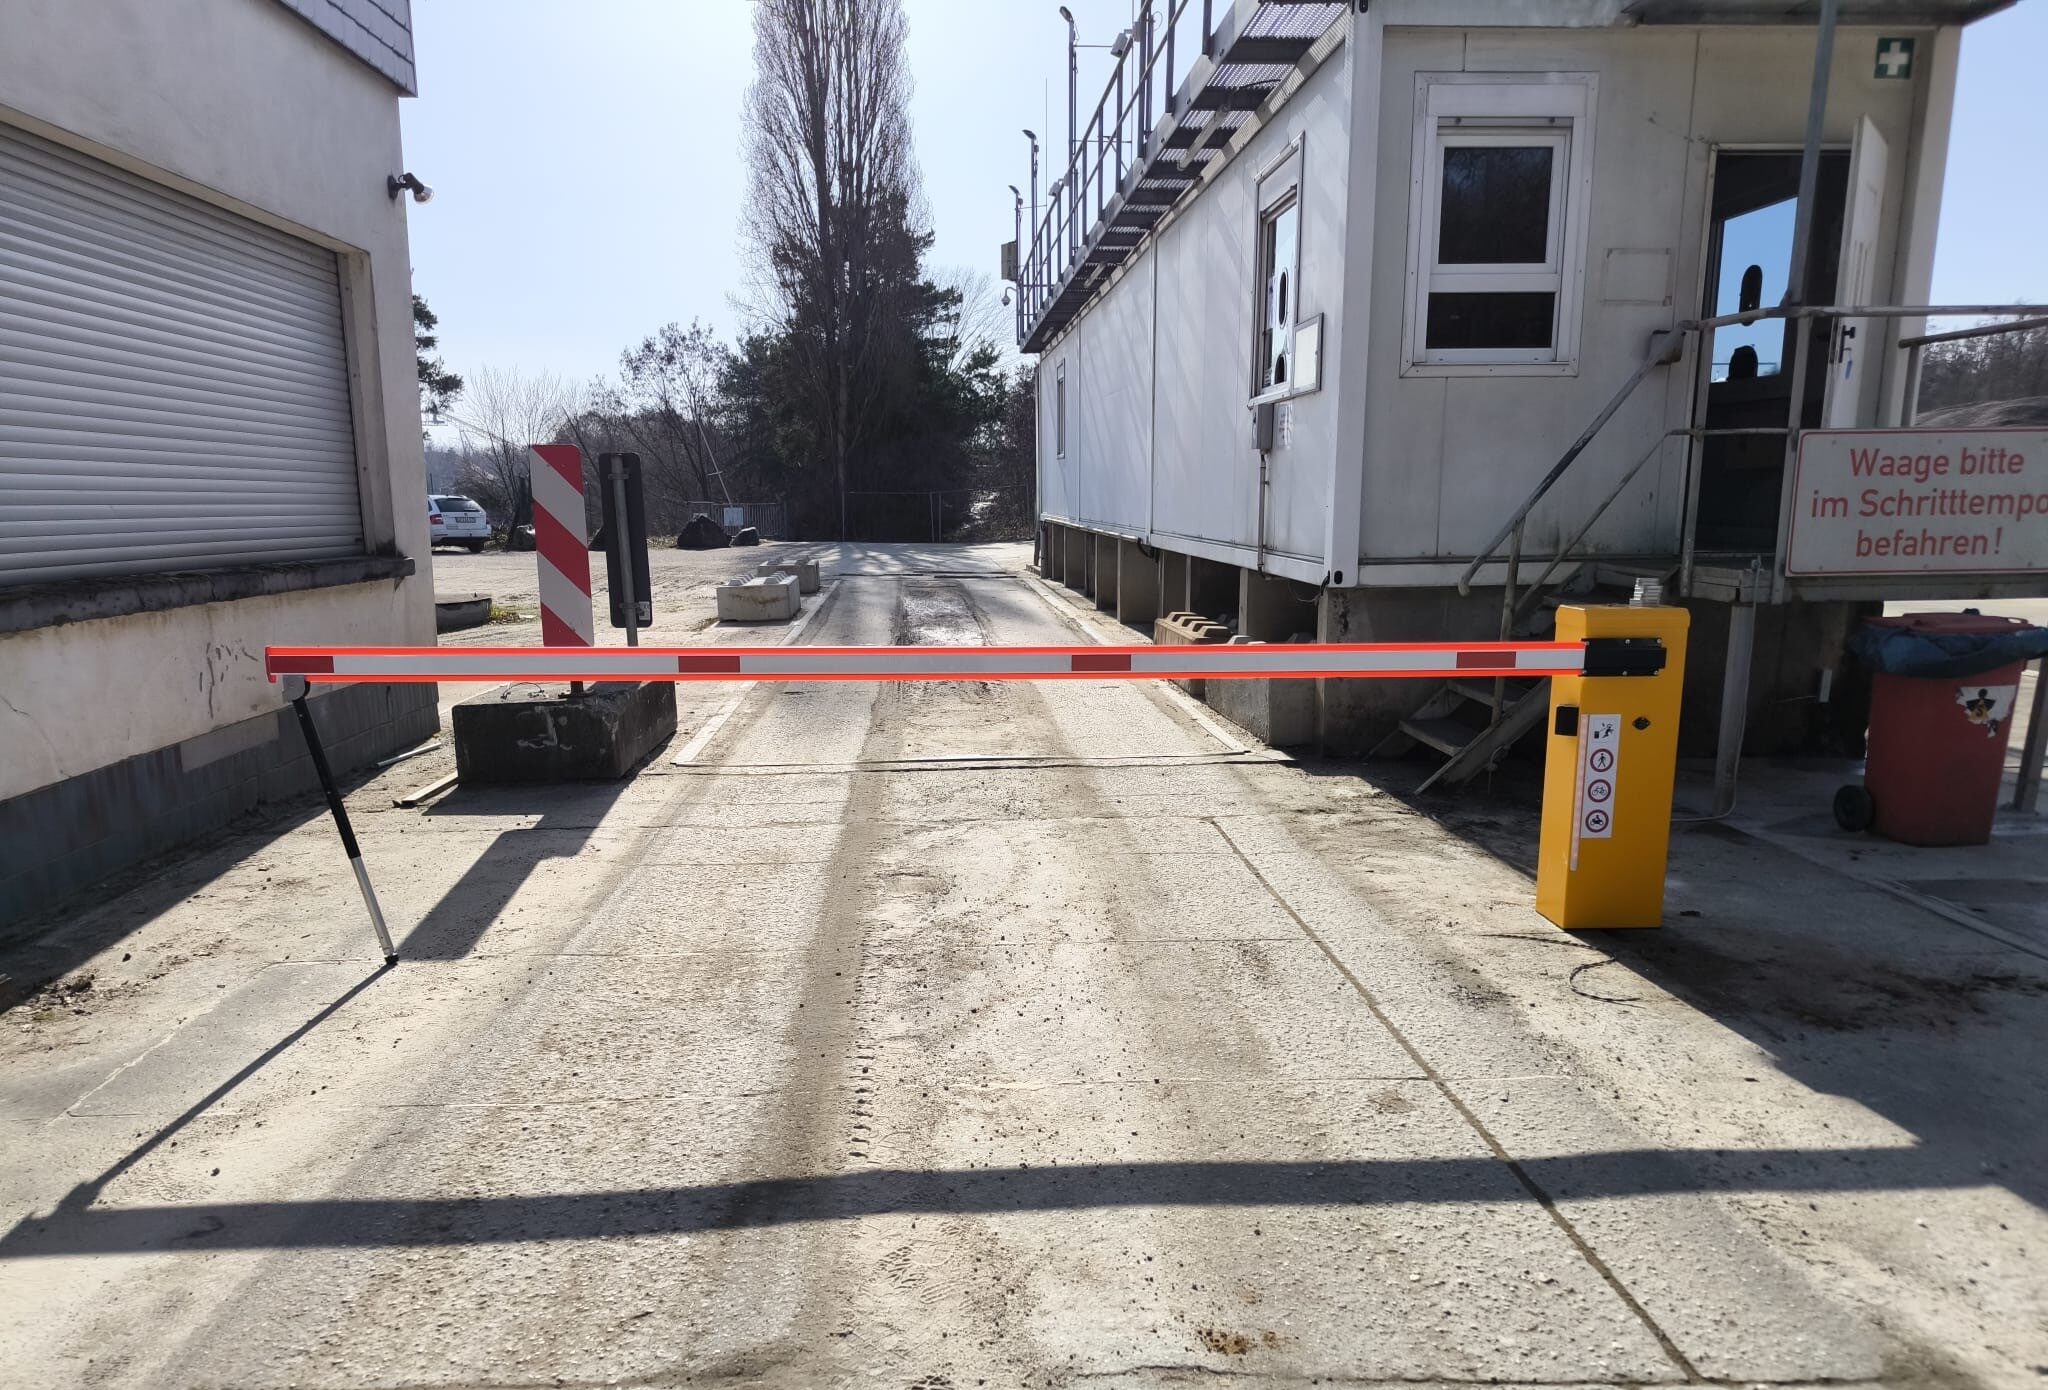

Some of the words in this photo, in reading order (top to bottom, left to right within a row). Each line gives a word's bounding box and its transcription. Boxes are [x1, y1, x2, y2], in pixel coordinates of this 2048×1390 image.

[1850, 448, 1949, 483] Waage
[1960, 447, 2025, 475] bitte
[1811, 490, 1848, 518] im
[1859, 488, 2048, 522] Schritttempo
[1856, 527, 2003, 557] befahren!
